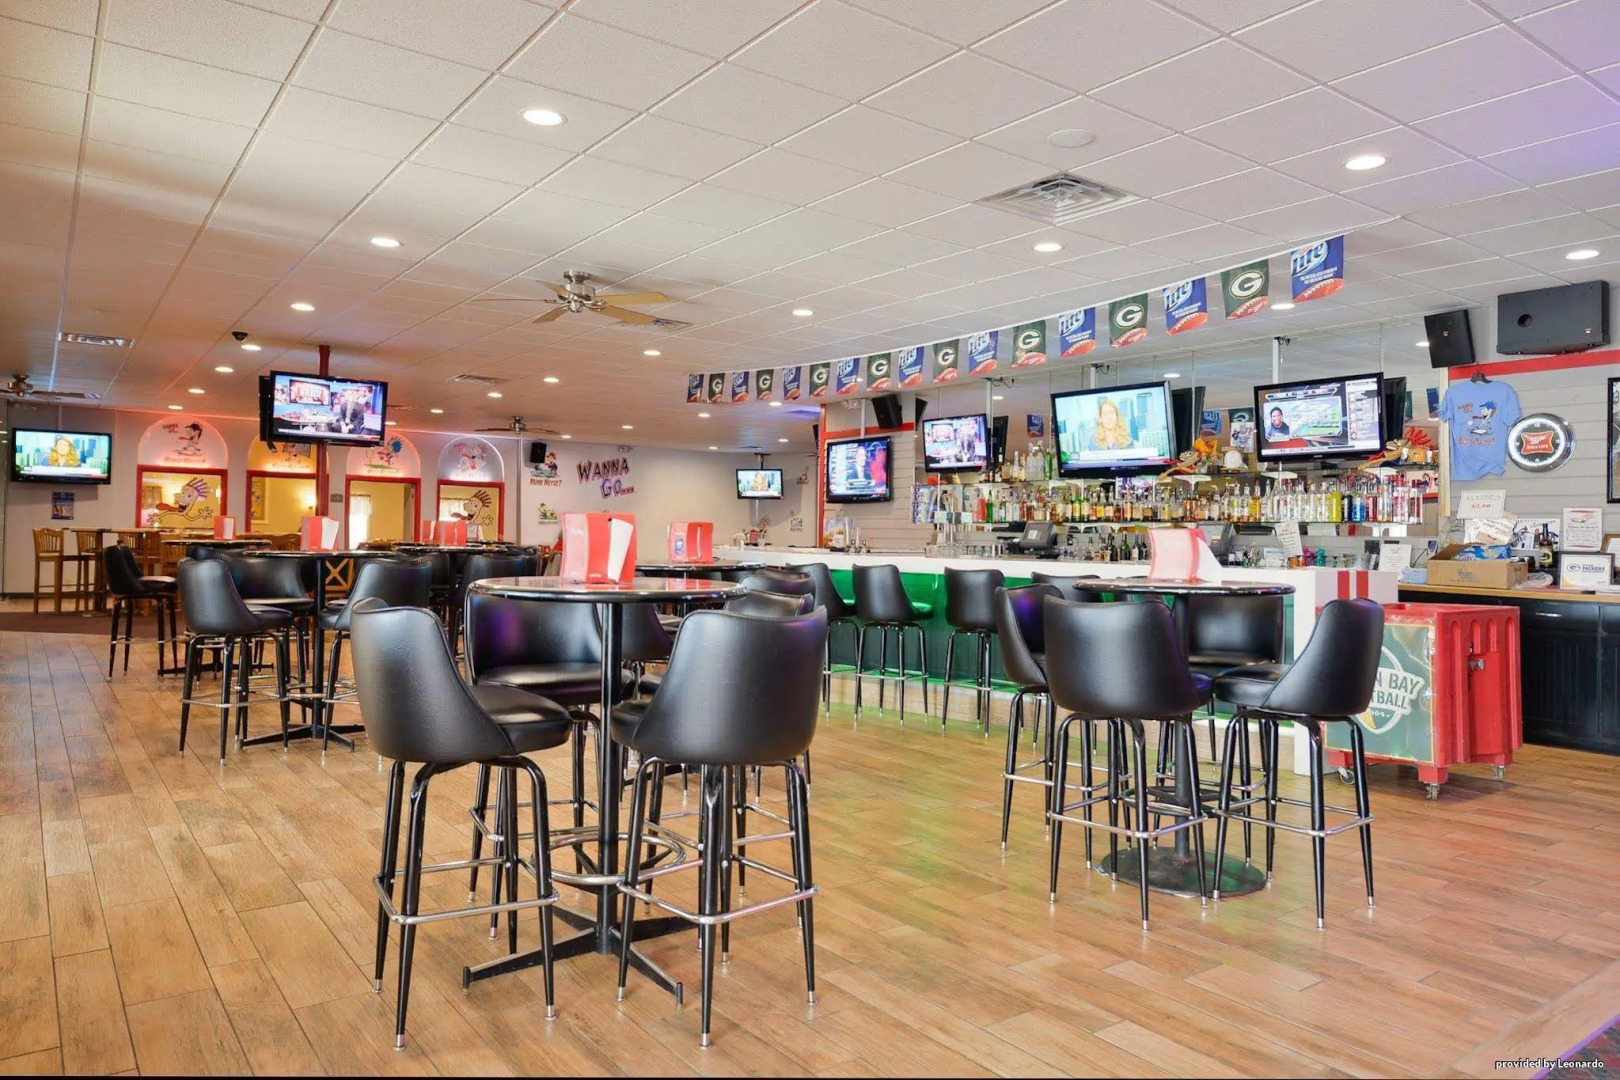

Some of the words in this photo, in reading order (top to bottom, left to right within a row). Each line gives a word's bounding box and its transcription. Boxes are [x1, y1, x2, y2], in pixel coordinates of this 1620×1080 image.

[577, 457, 630, 484] WANNA
[1388, 673, 1420, 695] BAY
[1371, 689, 1407, 710] TBALL
